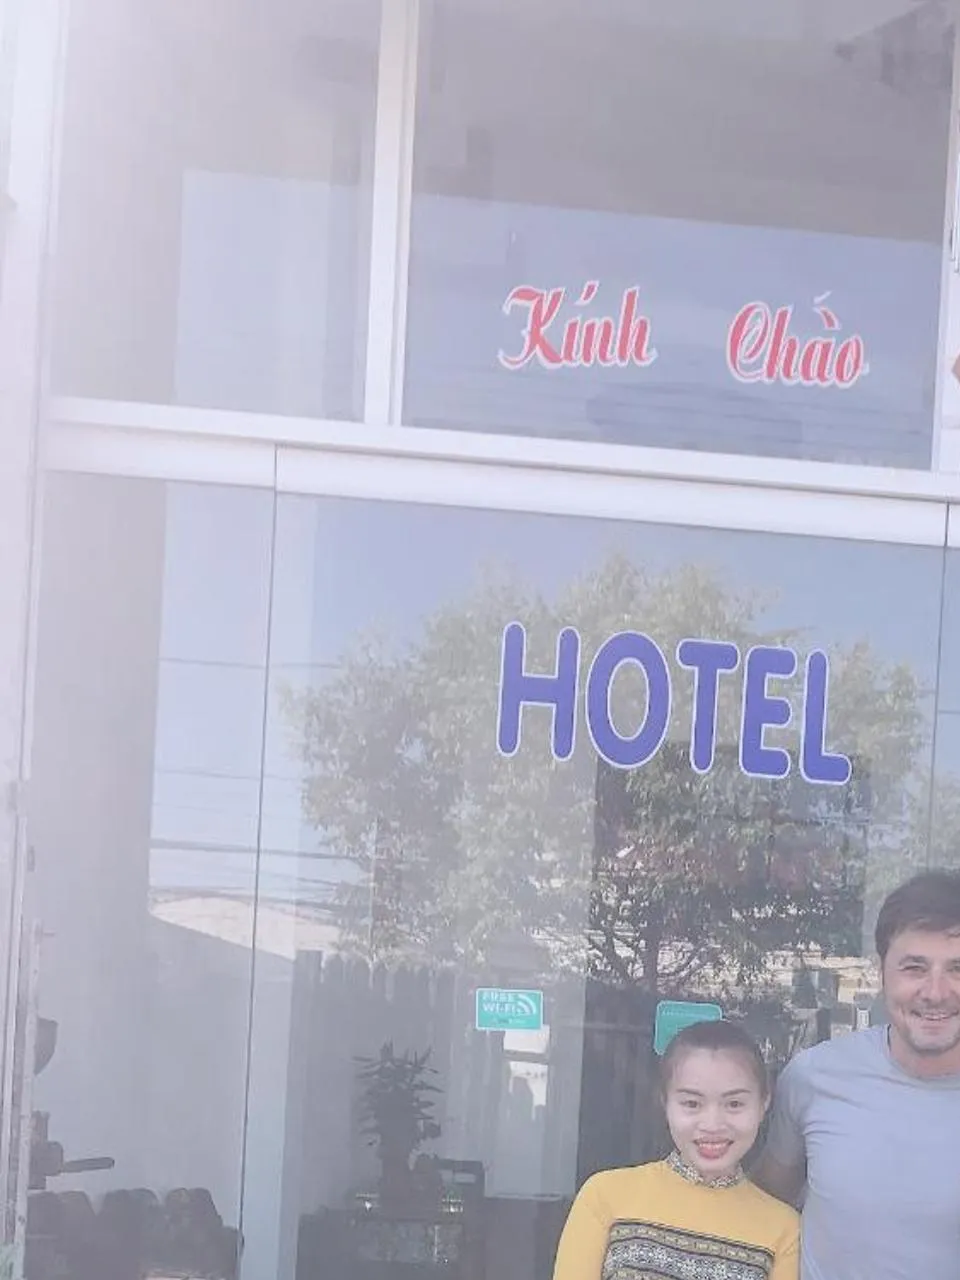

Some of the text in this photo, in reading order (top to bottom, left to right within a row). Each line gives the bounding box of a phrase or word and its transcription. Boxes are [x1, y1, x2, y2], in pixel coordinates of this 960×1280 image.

[498, 281, 657, 370] Kính
[727, 292, 869, 389] Chào
[496, 620, 853, 785] HOTEL
